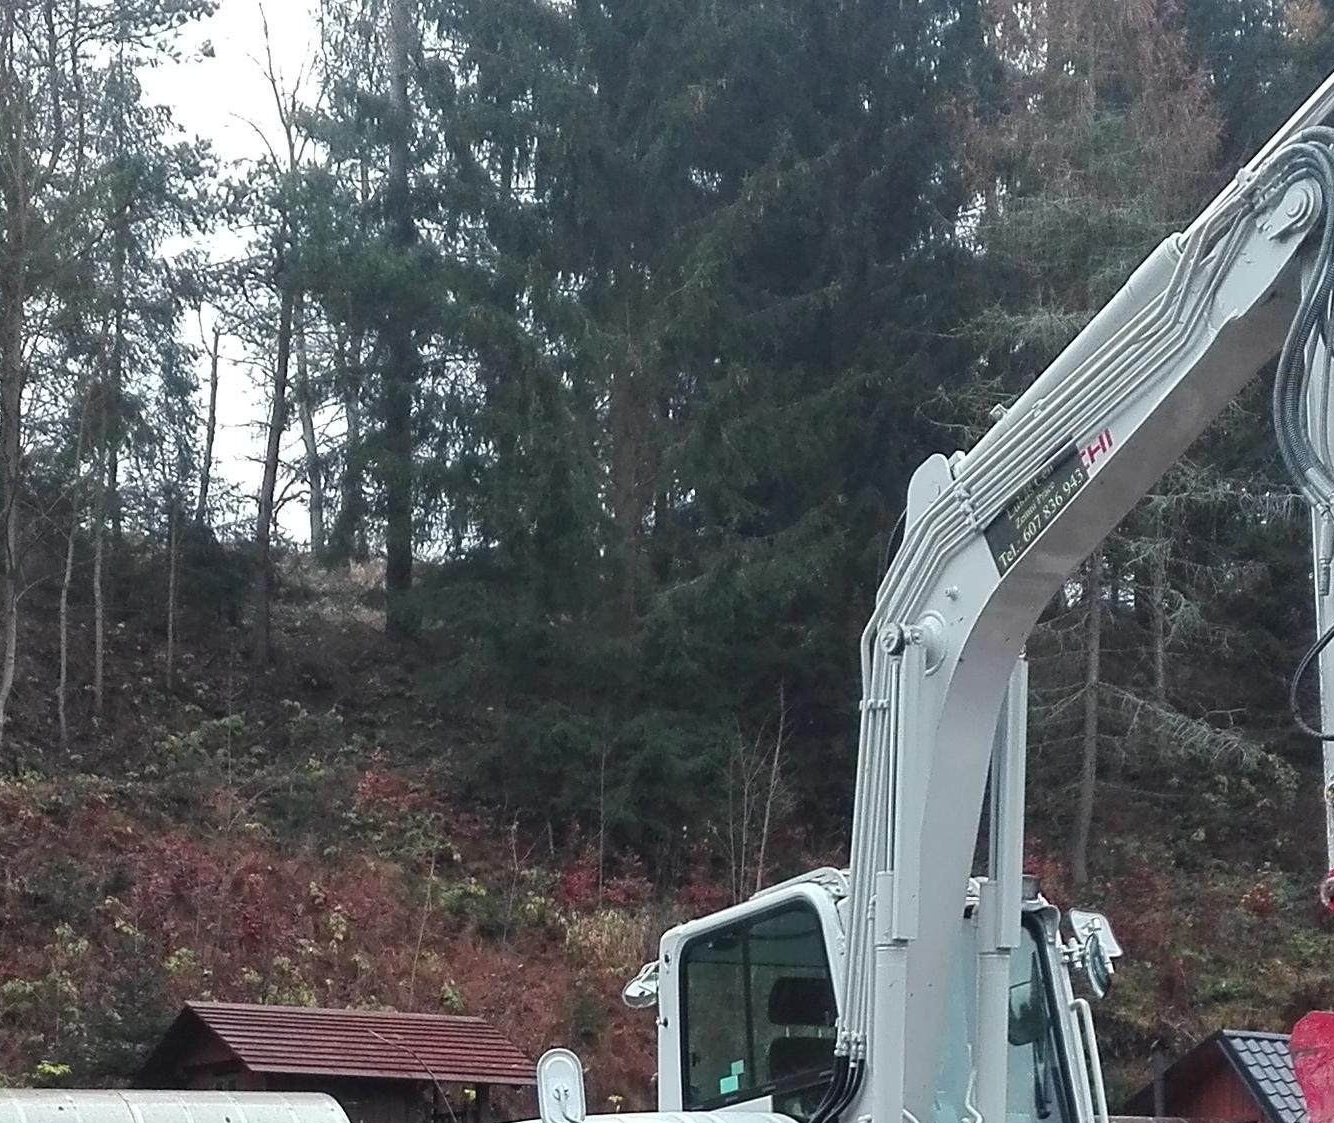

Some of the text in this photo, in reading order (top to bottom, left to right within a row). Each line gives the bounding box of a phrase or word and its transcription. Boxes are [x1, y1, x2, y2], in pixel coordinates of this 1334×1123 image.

[1022, 514, 1041, 542] 607
[1042, 491, 1063, 519] 836
[1062, 467, 1084, 496] 943
